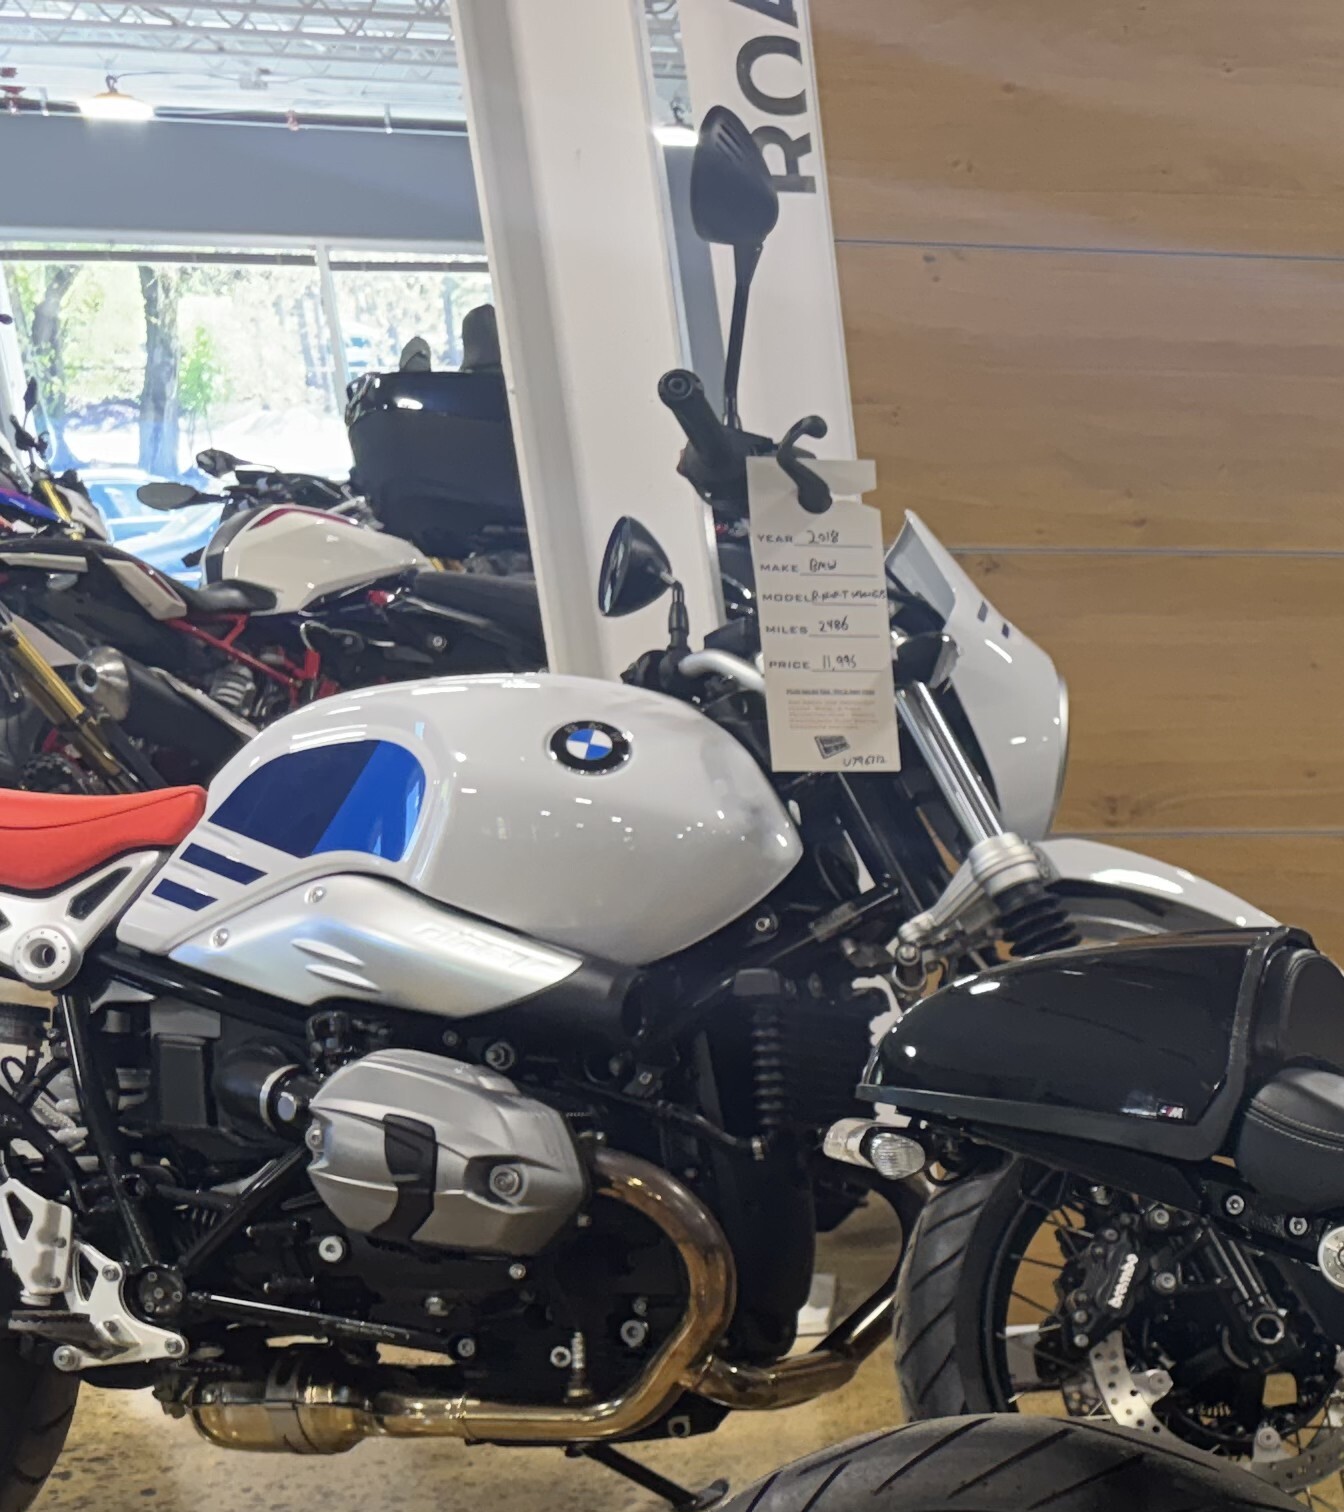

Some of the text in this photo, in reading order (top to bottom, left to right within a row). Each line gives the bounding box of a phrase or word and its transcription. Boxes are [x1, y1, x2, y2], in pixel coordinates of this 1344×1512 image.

[757, 529, 840, 544] YEAR 2018
[760, 557, 837, 573] MAKE BMW
[762, 593, 812, 602] MODEL
[765, 625, 808, 634] MILES
[769, 660, 810, 669] PRICE
[1107, 1253, 1139, 1309] brembo
